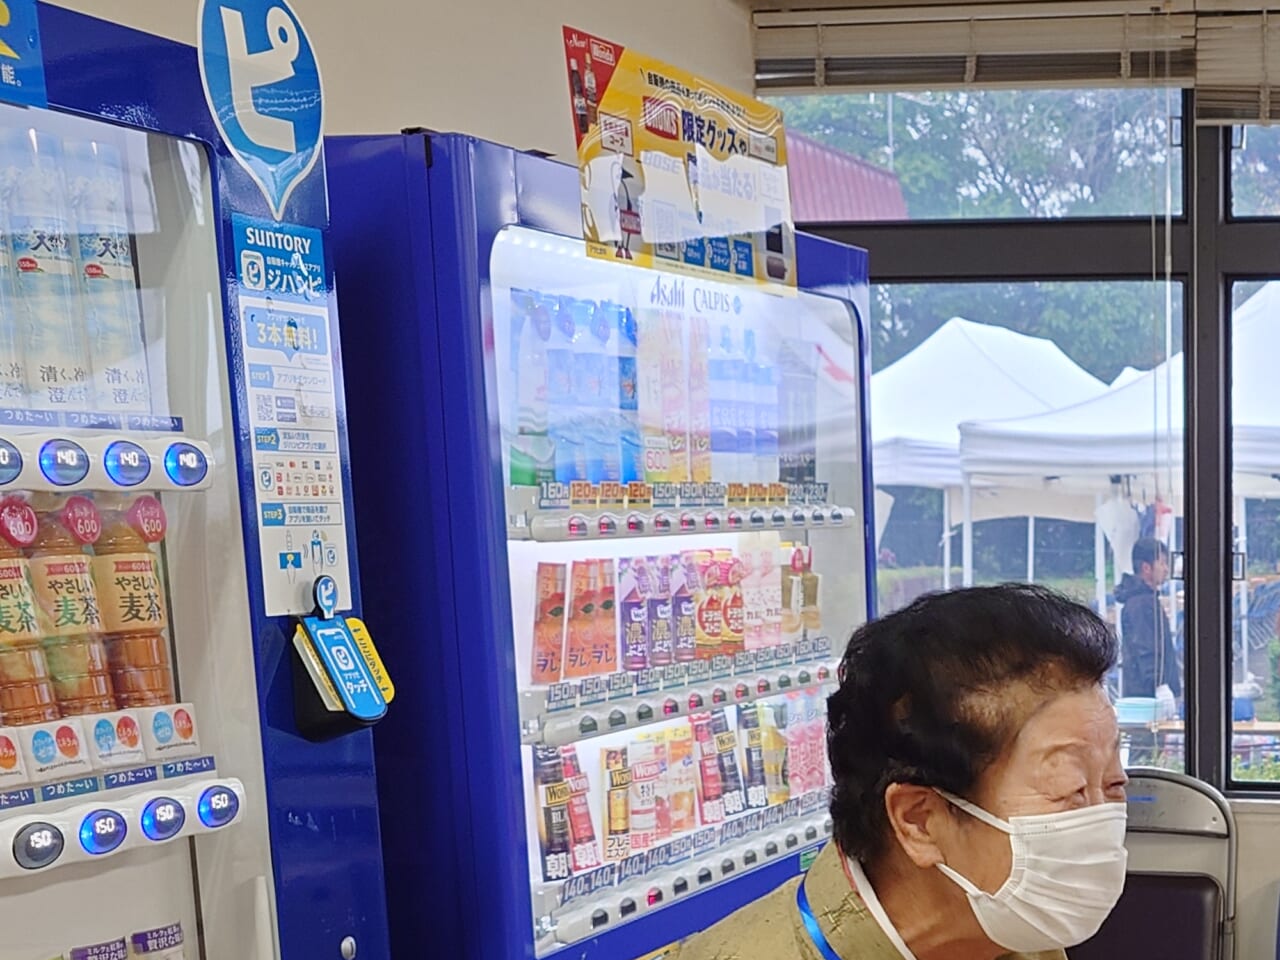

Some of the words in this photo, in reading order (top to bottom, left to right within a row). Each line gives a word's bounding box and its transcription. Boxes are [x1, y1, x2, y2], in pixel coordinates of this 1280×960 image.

[220, 6, 300, 153] ピ
[245, 227, 311, 254] SUNTORY
[650, 275, 685, 309] Asahi
[693, 287, 730, 313] CALPIS
[57, 449, 78, 466] 140
[120, 451, 139, 467] 140
[178, 452, 197, 468] 140
[10, 520, 32, 536] 600
[77, 519, 98, 534] 600
[143, 519, 162, 533] 600
[47, 576, 93, 595] やさしい
[115, 575, 157, 592] やさしい
[54, 596, 100, 628] 麦茶
[119, 592, 162, 623] 麦茶
[168, 758, 210, 774] つめた〜い
[110, 768, 153, 784] つめた〜い
[47, 779, 94, 796] つめた〜い
[211, 793, 229, 809] 150
[156, 804, 175, 821] 150
[95, 817, 116, 834] 150
[30, 830, 52, 848] 150
